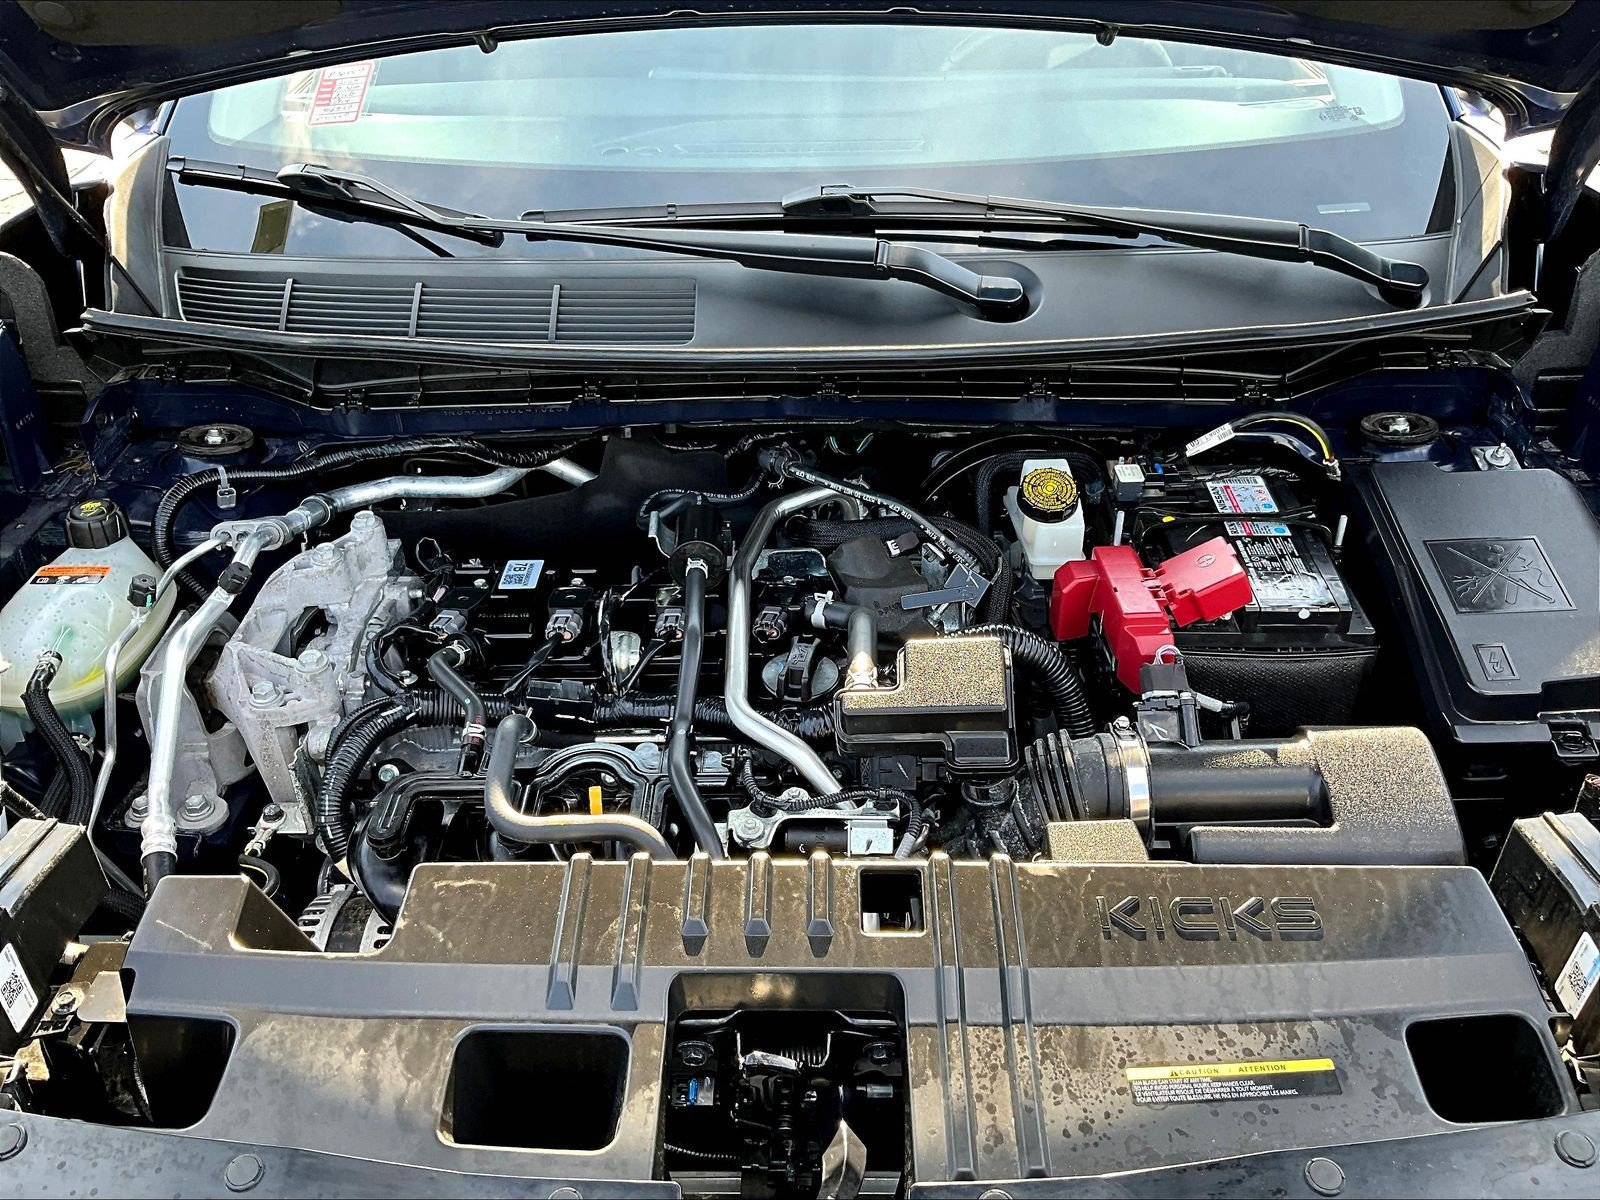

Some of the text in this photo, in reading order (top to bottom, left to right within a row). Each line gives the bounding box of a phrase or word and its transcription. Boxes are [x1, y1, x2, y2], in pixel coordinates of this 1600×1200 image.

[1210, 486, 1229, 511] NISSAN
[1096, 896, 1324, 940] KICKS
[1179, 1067, 1219, 1076] CAUTION
[1238, 1064, 1287, 1073] ATTENTION
